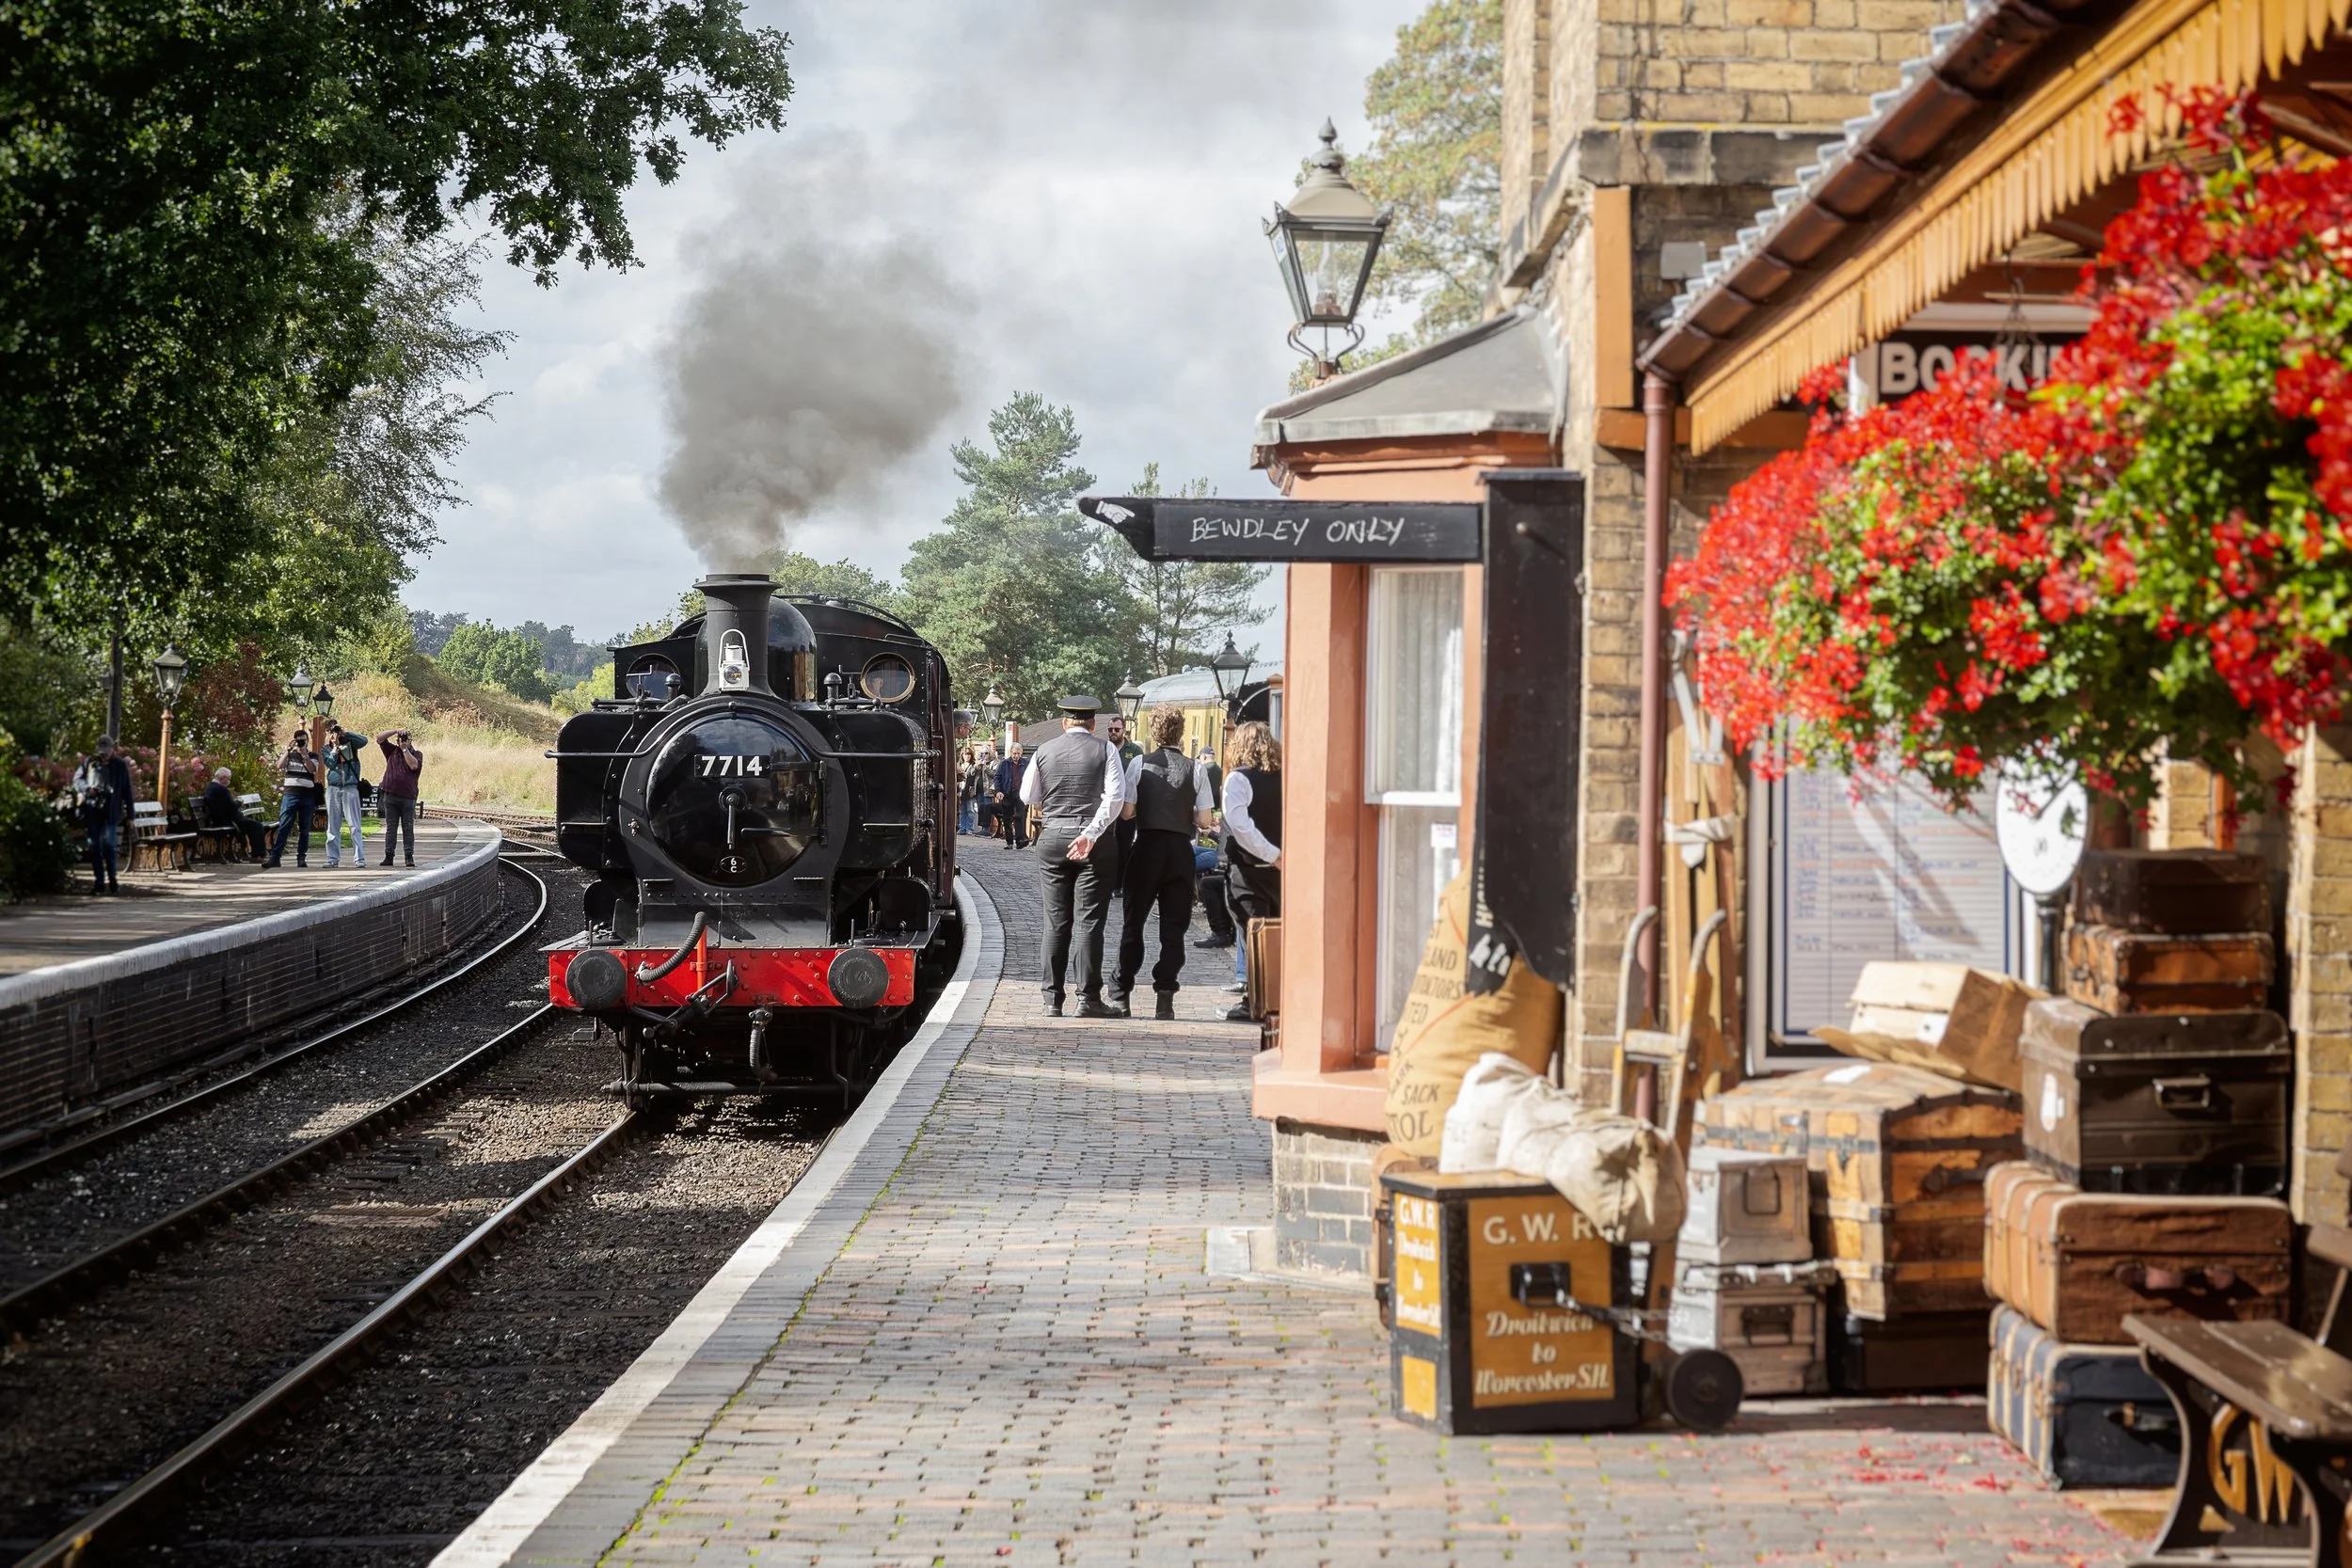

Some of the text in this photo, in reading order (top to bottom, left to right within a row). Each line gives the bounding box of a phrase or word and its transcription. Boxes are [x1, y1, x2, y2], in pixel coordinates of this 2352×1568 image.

[1189, 515, 1405, 546] BEWDLEY ONLY
[701, 755, 763, 776] 7714
[730, 857, 738, 866] 6
[1402, 1084, 1440, 1105] SACK
[1532, 1342, 1557, 1364] to
[1475, 1369, 1576, 1395] Worcester
